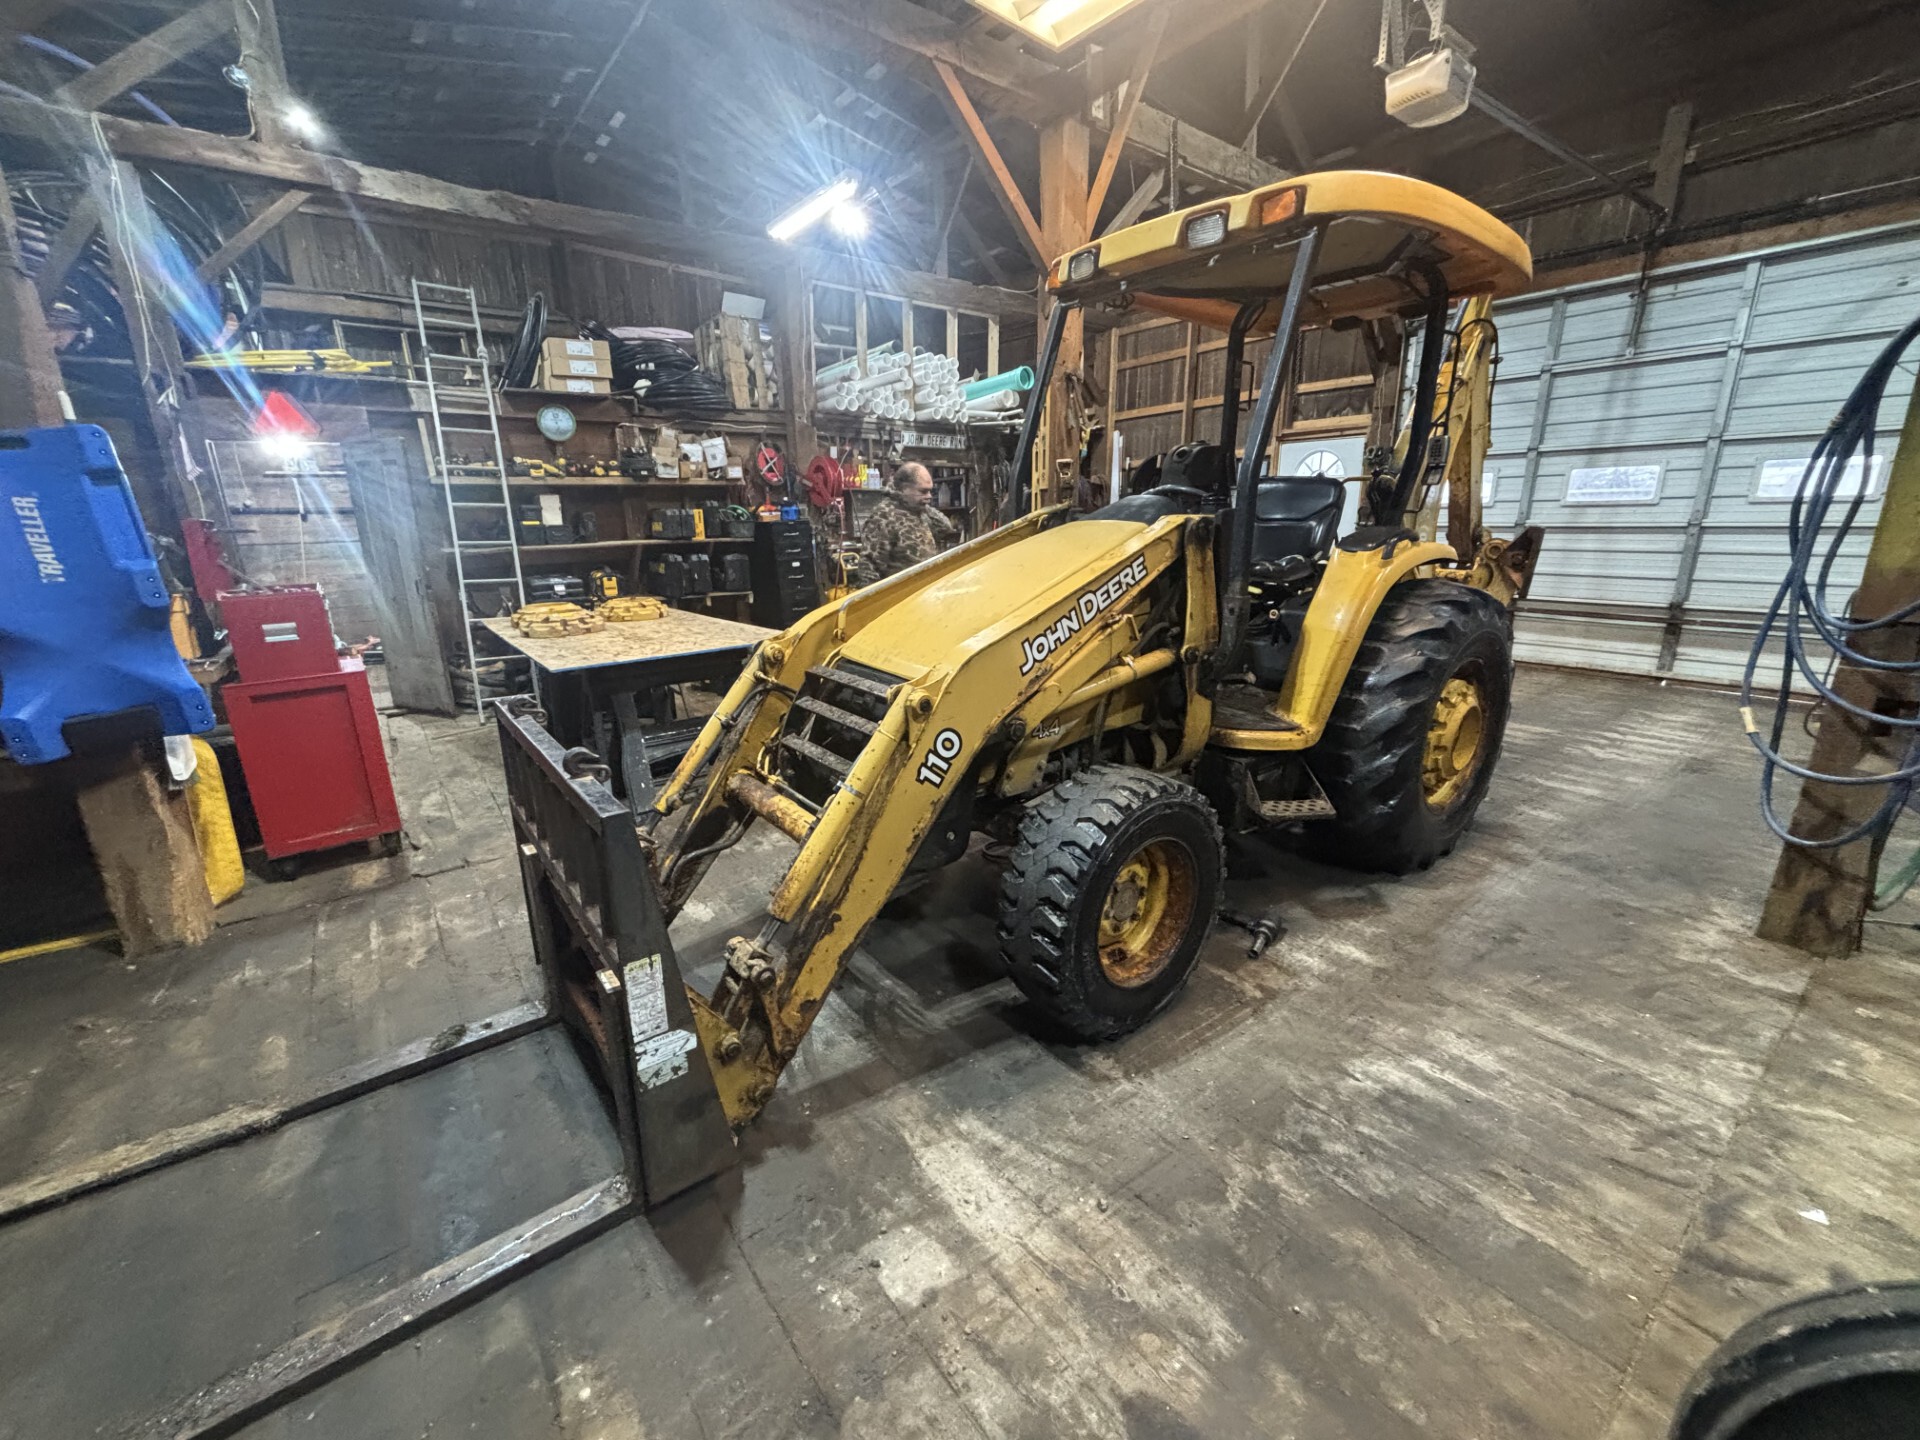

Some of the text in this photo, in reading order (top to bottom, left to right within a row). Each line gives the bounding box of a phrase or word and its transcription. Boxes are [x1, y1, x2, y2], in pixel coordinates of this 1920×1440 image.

[927, 434, 948, 447] DEERE
[11, 496, 66, 583] TRAVELLER
[1020, 554, 1148, 676] JOHN DEERE
[916, 728, 962, 788] 110
